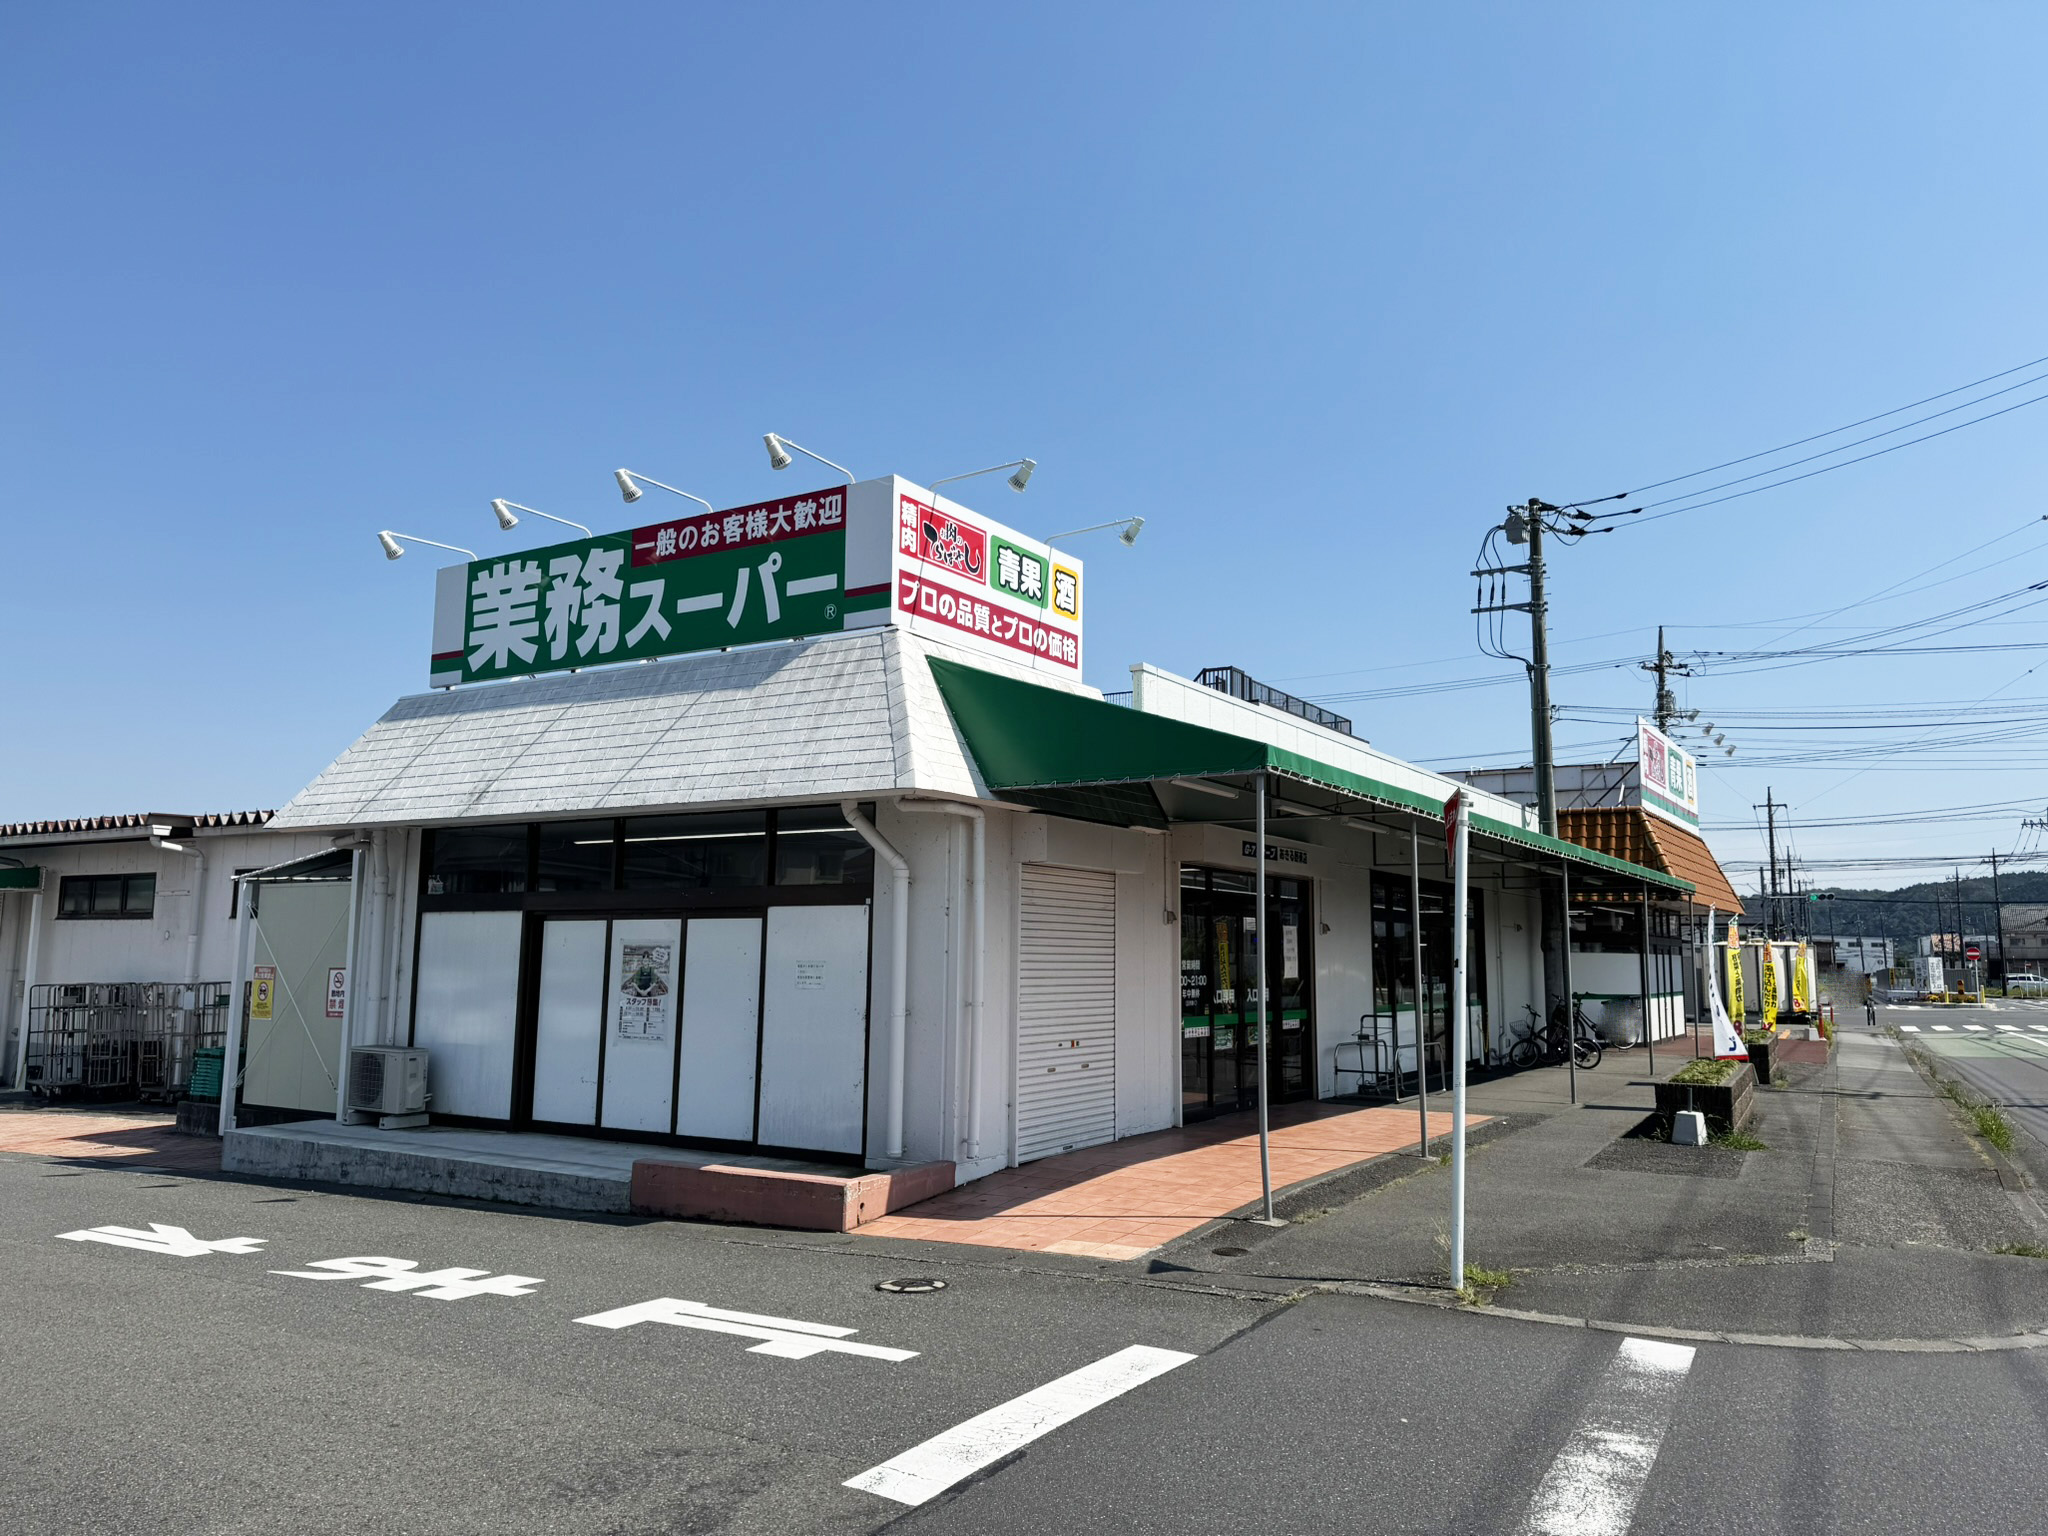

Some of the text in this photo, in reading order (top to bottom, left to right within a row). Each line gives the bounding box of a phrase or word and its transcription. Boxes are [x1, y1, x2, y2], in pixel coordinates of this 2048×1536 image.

[635, 495, 842, 557] 一般のお客様大歓迎
[901, 500, 917, 553] 精肉
[997, 546, 1042, 600] 青果
[1055, 570, 1076, 614] 酒
[467, 548, 838, 673] 業務スーパー
[902, 578, 1077, 663] プロの品質とプロの価格
